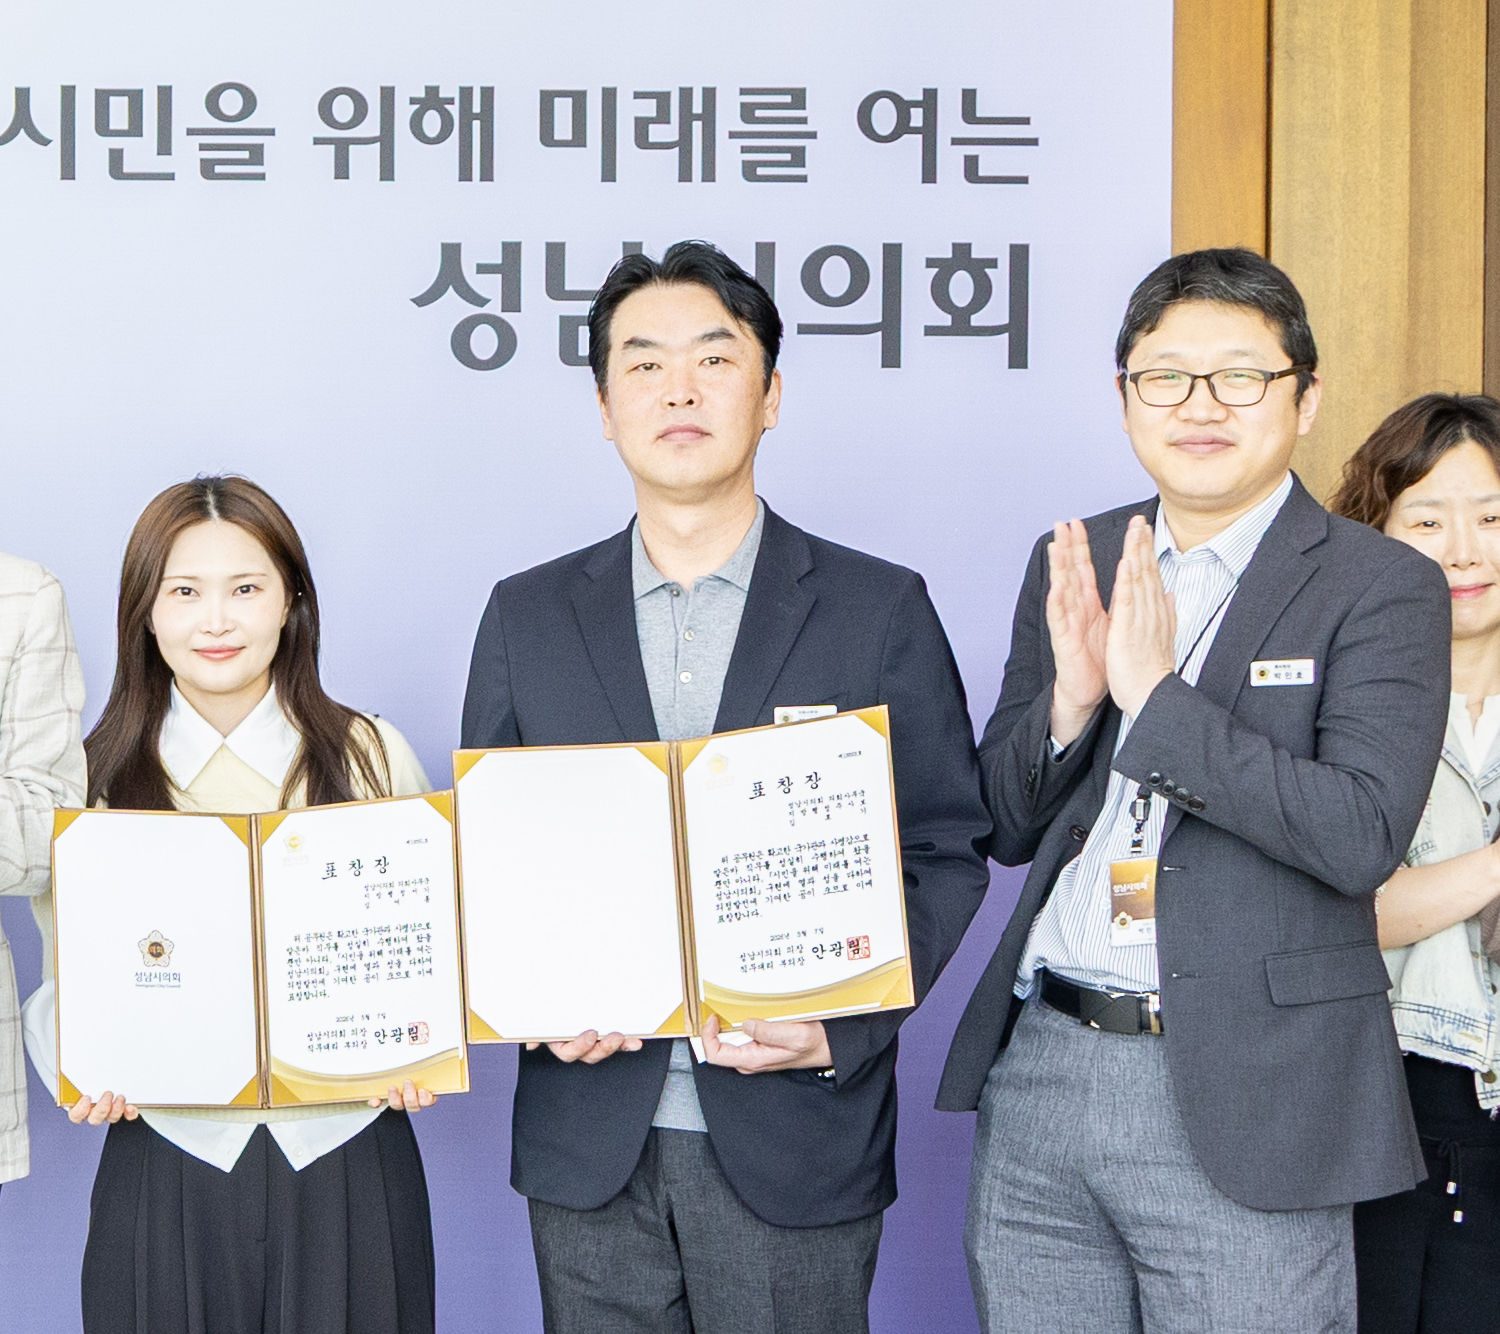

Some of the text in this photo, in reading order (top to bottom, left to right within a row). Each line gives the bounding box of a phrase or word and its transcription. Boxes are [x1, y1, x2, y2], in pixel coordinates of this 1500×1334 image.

[313, 85, 496, 183] 위해
[538, 86, 819, 184] 미래를
[856, 88, 1040, 186] 여는
[410, 240, 1031, 371] 성남의회
[134, 971, 181, 983] 성남시의회
